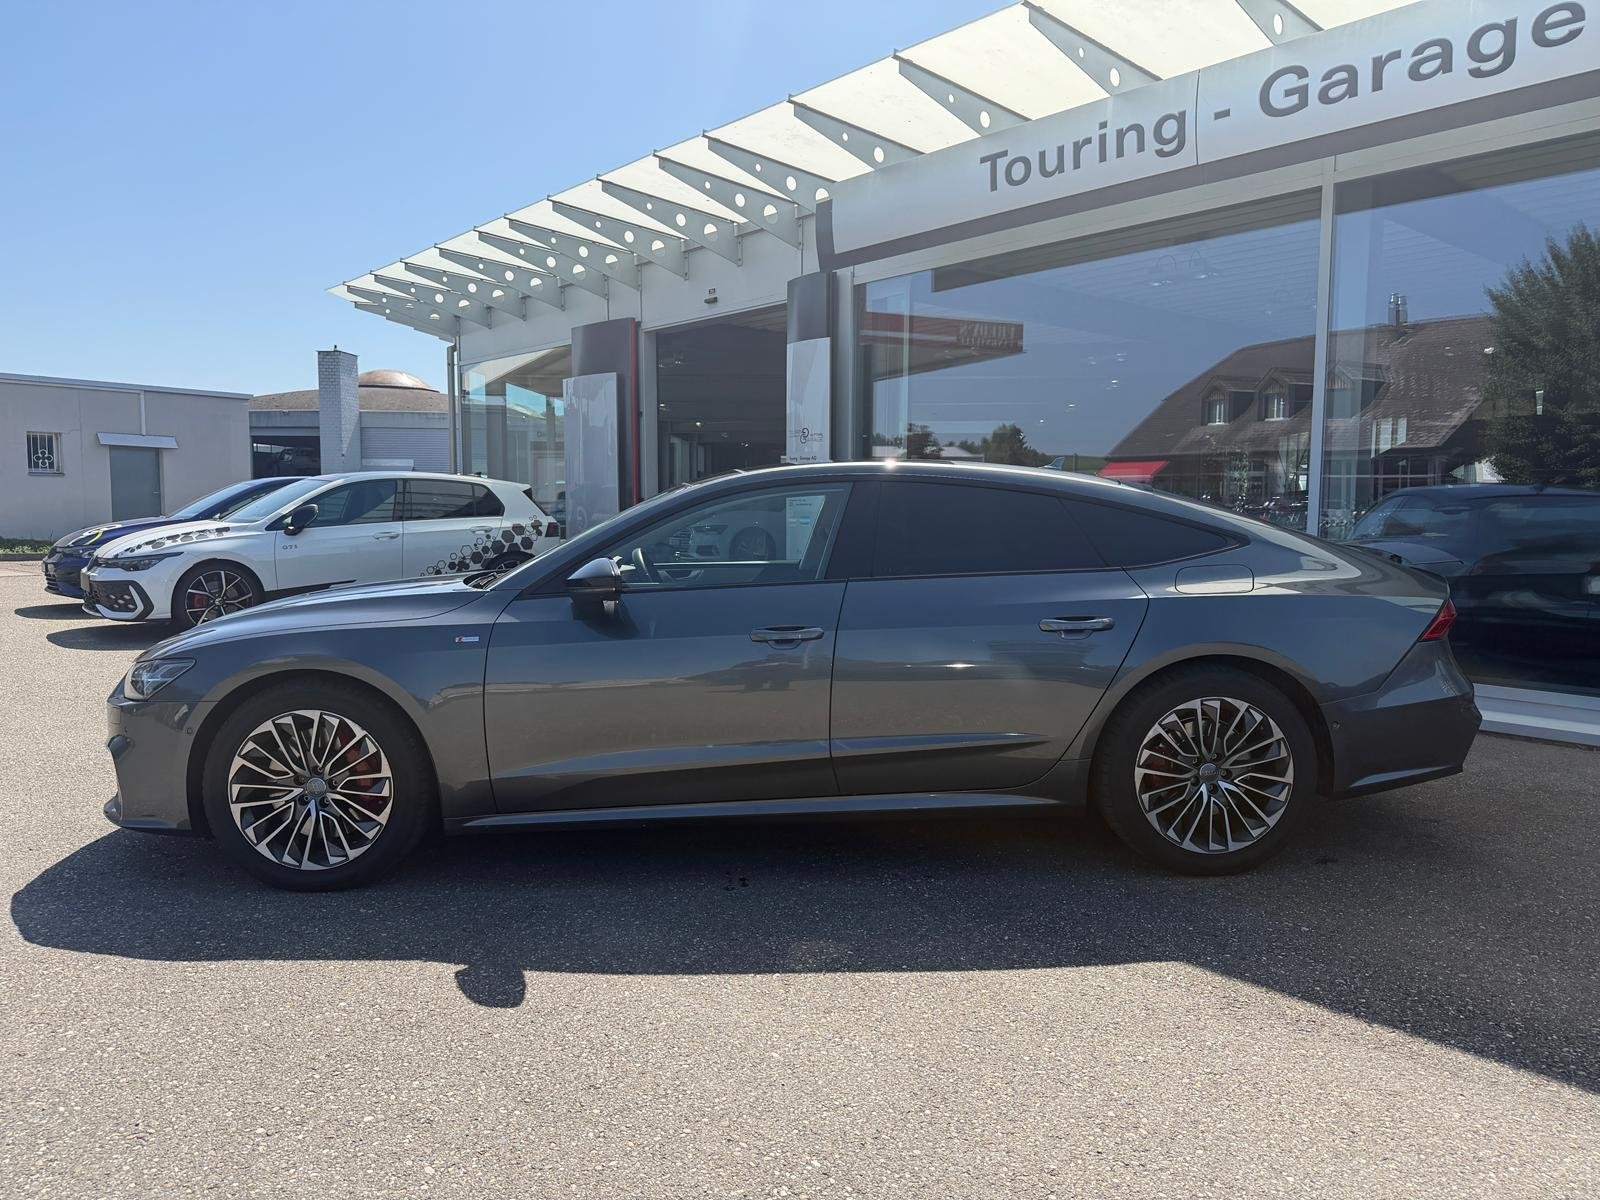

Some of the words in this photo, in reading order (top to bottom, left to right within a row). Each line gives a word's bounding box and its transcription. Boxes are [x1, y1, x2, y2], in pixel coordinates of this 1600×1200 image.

[979, 108, 1188, 193] Touring
[1213, 108, 1231, 121] -
[1258, 1, 1586, 118] Garage
